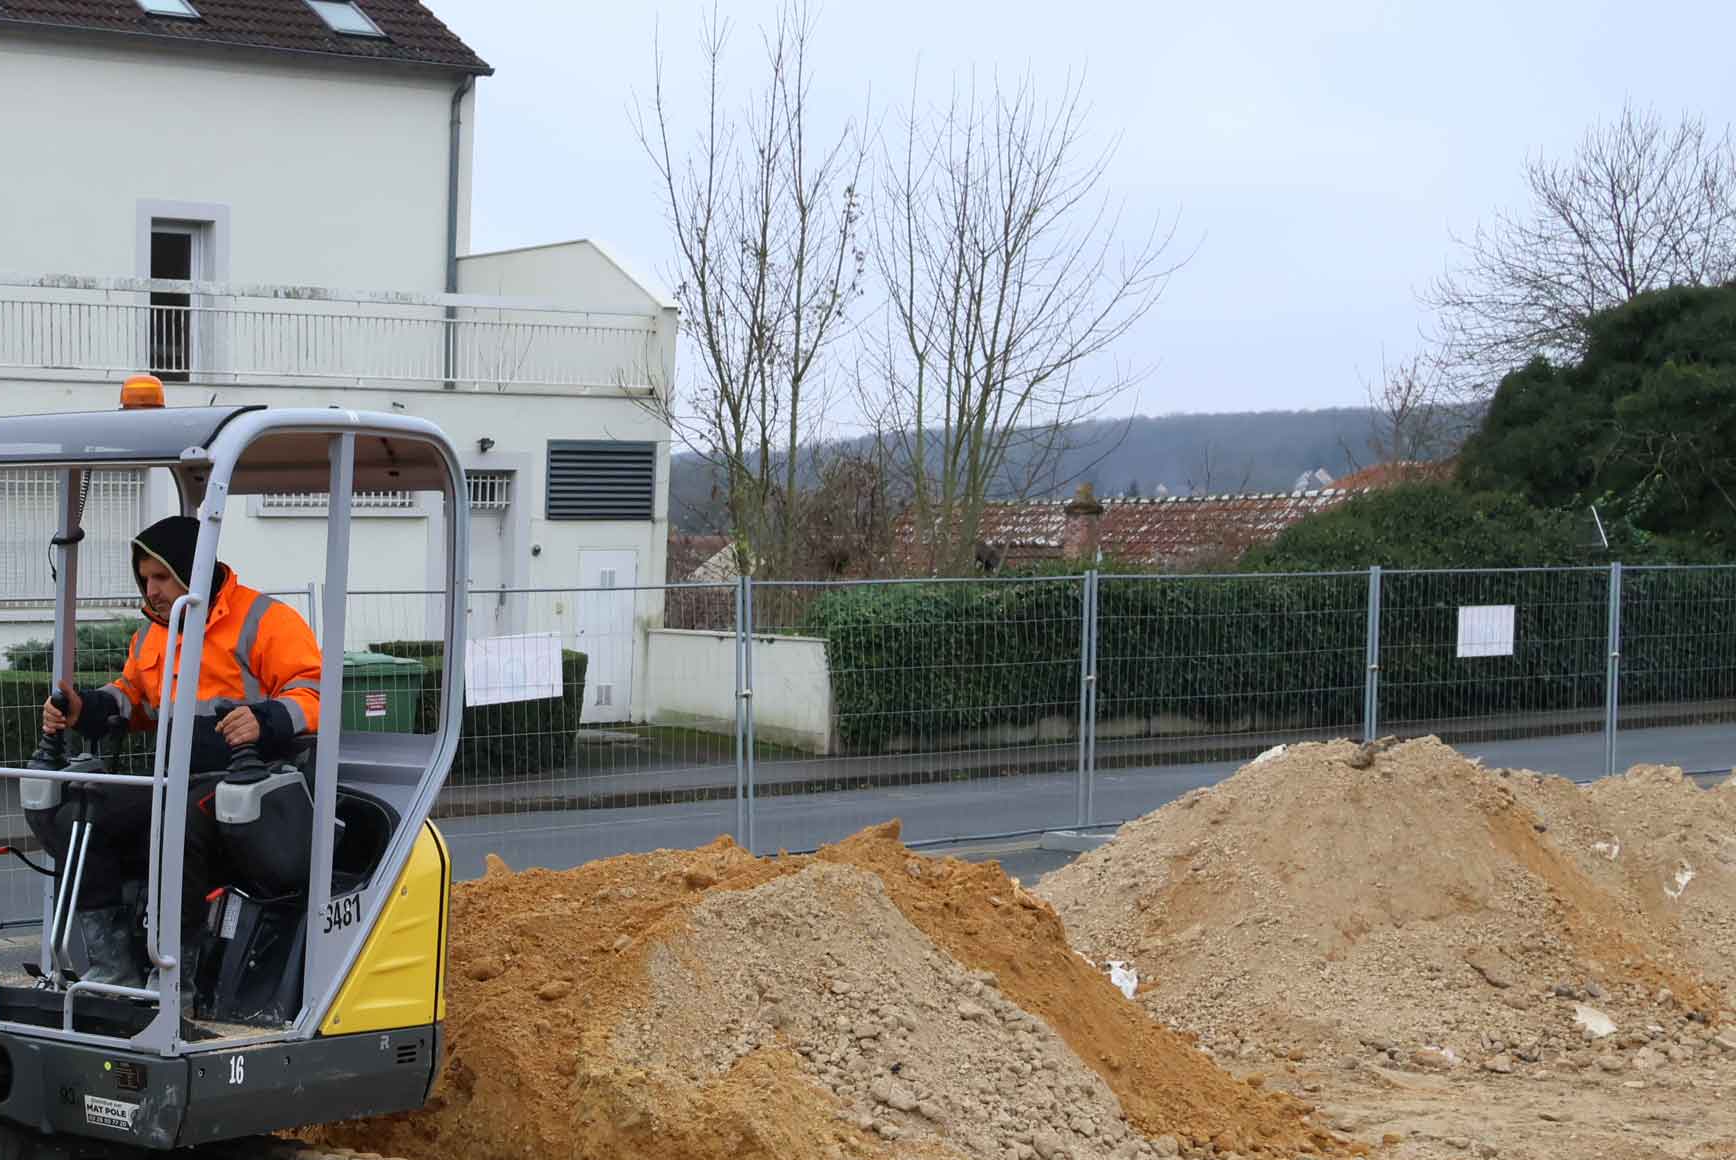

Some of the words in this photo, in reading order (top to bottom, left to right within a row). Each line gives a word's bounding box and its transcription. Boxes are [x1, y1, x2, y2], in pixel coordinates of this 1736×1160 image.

[228, 1055, 244, 1084] 16
[87, 1104, 103, 1113] MAT
[105, 1108, 127, 1117] POLE
